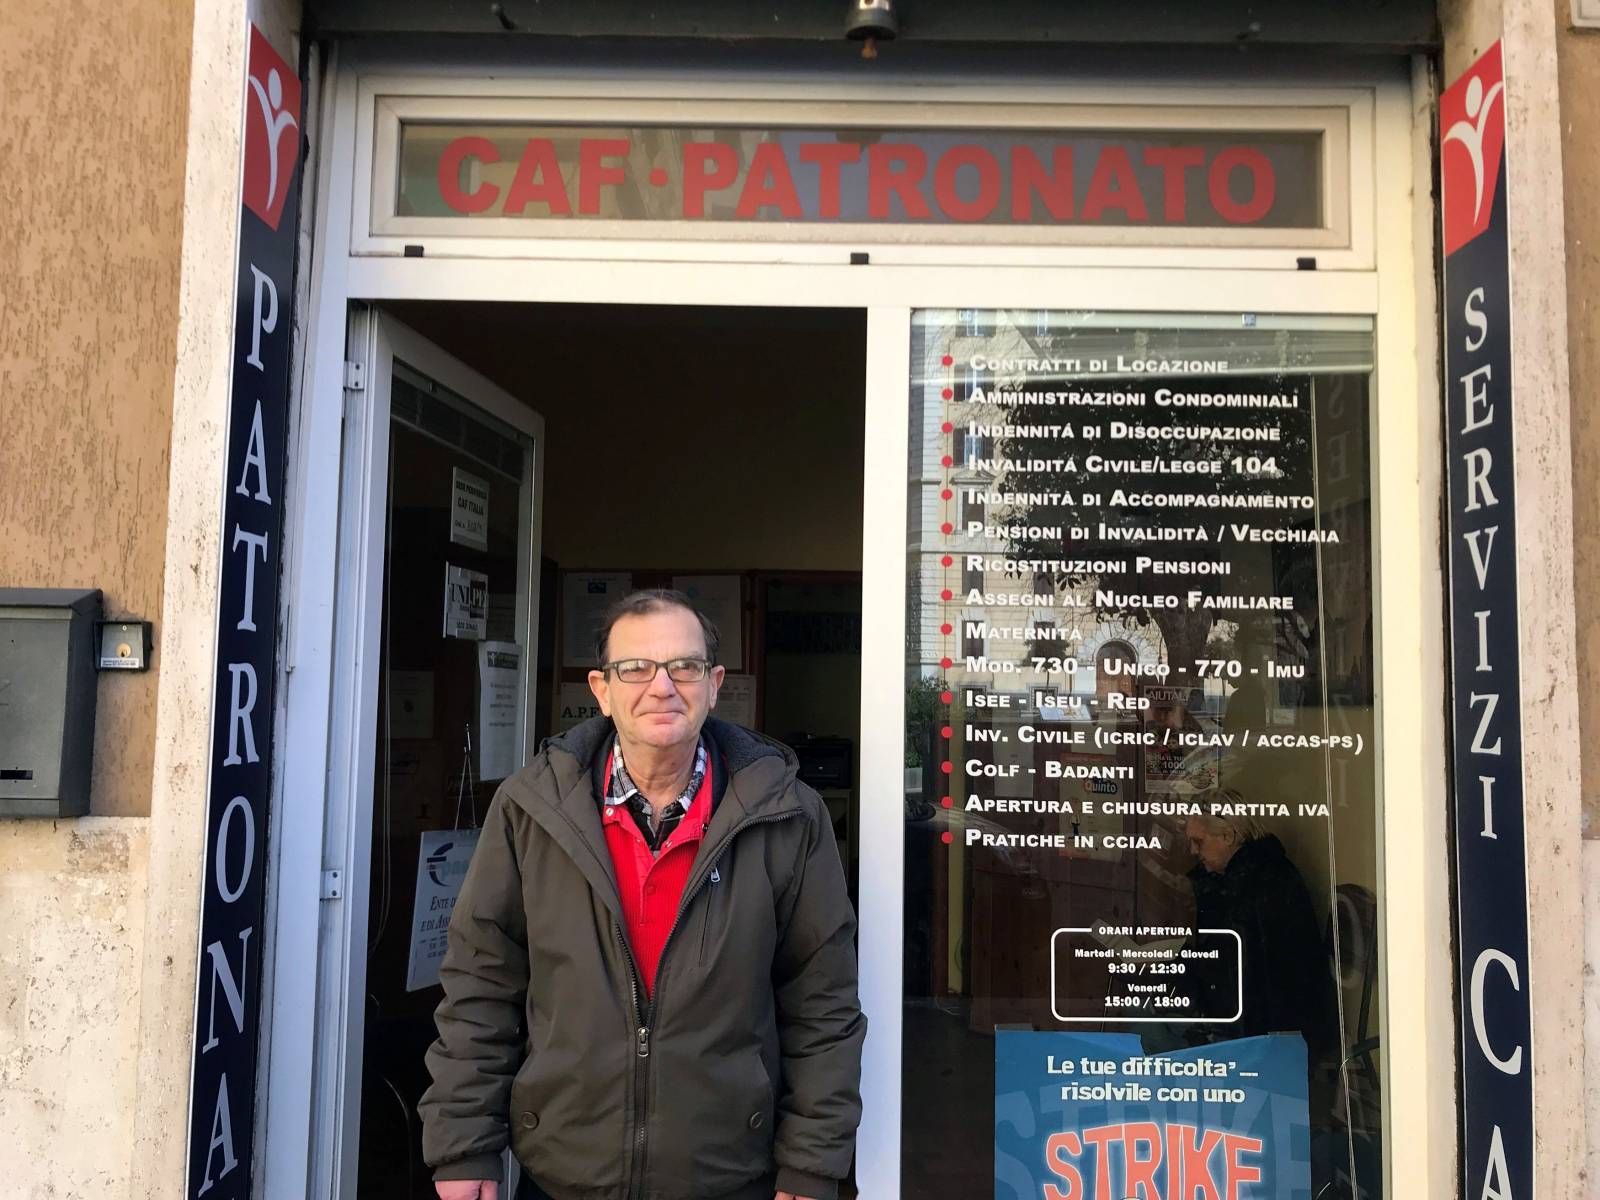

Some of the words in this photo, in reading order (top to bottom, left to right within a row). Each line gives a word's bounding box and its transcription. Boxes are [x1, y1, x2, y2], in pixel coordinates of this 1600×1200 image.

[437, 136, 630, 217] CAF
[682, 142, 1276, 224] PATRONATO
[969, 355, 1081, 372] CONTRATTI
[1089, 359, 1108, 372] DI
[1117, 355, 1229, 374] LOCAZIONE
[968, 388, 1146, 407] AMMINISTRAZIONI
[1154, 389, 1299, 409] CONDOMINIALI
[1082, 426, 1101, 440] DI
[1110, 422, 1281, 441] DISOCCUPAZIONE
[1085, 455, 1222, 475] CIVILE/LEGGE
[1231, 456, 1277, 475] 104
[1082, 493, 1101, 507] DI
[1109, 489, 1315, 509] ACCOMPAGNAMENTO
[967, 521, 1062, 540] PENSIONI
[1070, 526, 1089, 540] DI
[1217, 524, 1225, 543] /
[1231, 524, 1340, 544] VECCHIAIA
[966, 555, 1127, 574] RICOSTITUZIONI
[1136, 556, 1231, 575] PENSIONI
[1461, 287, 1502, 839] SERVIZI
[966, 588, 1054, 606] ASSEGNI
[1063, 593, 1087, 607] AL
[1095, 590, 1179, 608] NUCLEO
[1188, 592, 1294, 610] FAMILIARE
[965, 656, 1022, 674] MOD.
[1031, 657, 1078, 675] 730
[1103, 658, 1170, 676] UNICO
[1195, 659, 1242, 678] 770
[1268, 660, 1305, 679] IMU
[965, 691, 1010, 708] ISEE
[1036, 691, 1082, 709] ISEU
[1107, 693, 1150, 711] RED
[198, 262, 279, 1200] PATRONA
[965, 725, 1009, 743] INV.
[1018, 725, 1086, 744] CIVILE
[1094, 727, 1156, 749] (ICRIC
[1163, 728, 1170, 746] /
[1178, 732, 1235, 748] ICLAV
[1242, 729, 1249, 748] /
[1257, 733, 1364, 755] ACCAS-PS)
[965, 759, 1020, 778] COLF
[1045, 761, 1134, 779] BADANTI
[965, 794, 1073, 814] APERTURA
[1082, 801, 1094, 814] E
[1102, 801, 1203, 816] CHIUSURA
[1211, 802, 1291, 817] PARTITA
[1298, 803, 1330, 817] IVA
[965, 829, 1066, 849] PRATICHE
[1074, 835, 1094, 849] IN
[1102, 835, 1162, 850] CCIAA
[1098, 926, 1134, 936] ORARI
[1135, 926, 1193, 937] APERTURA
[1107, 962, 1136, 974] 9:30
[1150, 963, 1186, 974] 12:30
[1104, 996, 1141, 1008] 15:00
[1154, 996, 1191, 1008] 18:00
[1047, 1055, 1074, 1075] Le
[1081, 1058, 1117, 1075] tue
[1061, 1082, 1152, 1102] risolvile
[1157, 1086, 1198, 1103] con
[1203, 1088, 1246, 1104] uno
[1043, 1121, 1264, 1200] STRIKE
